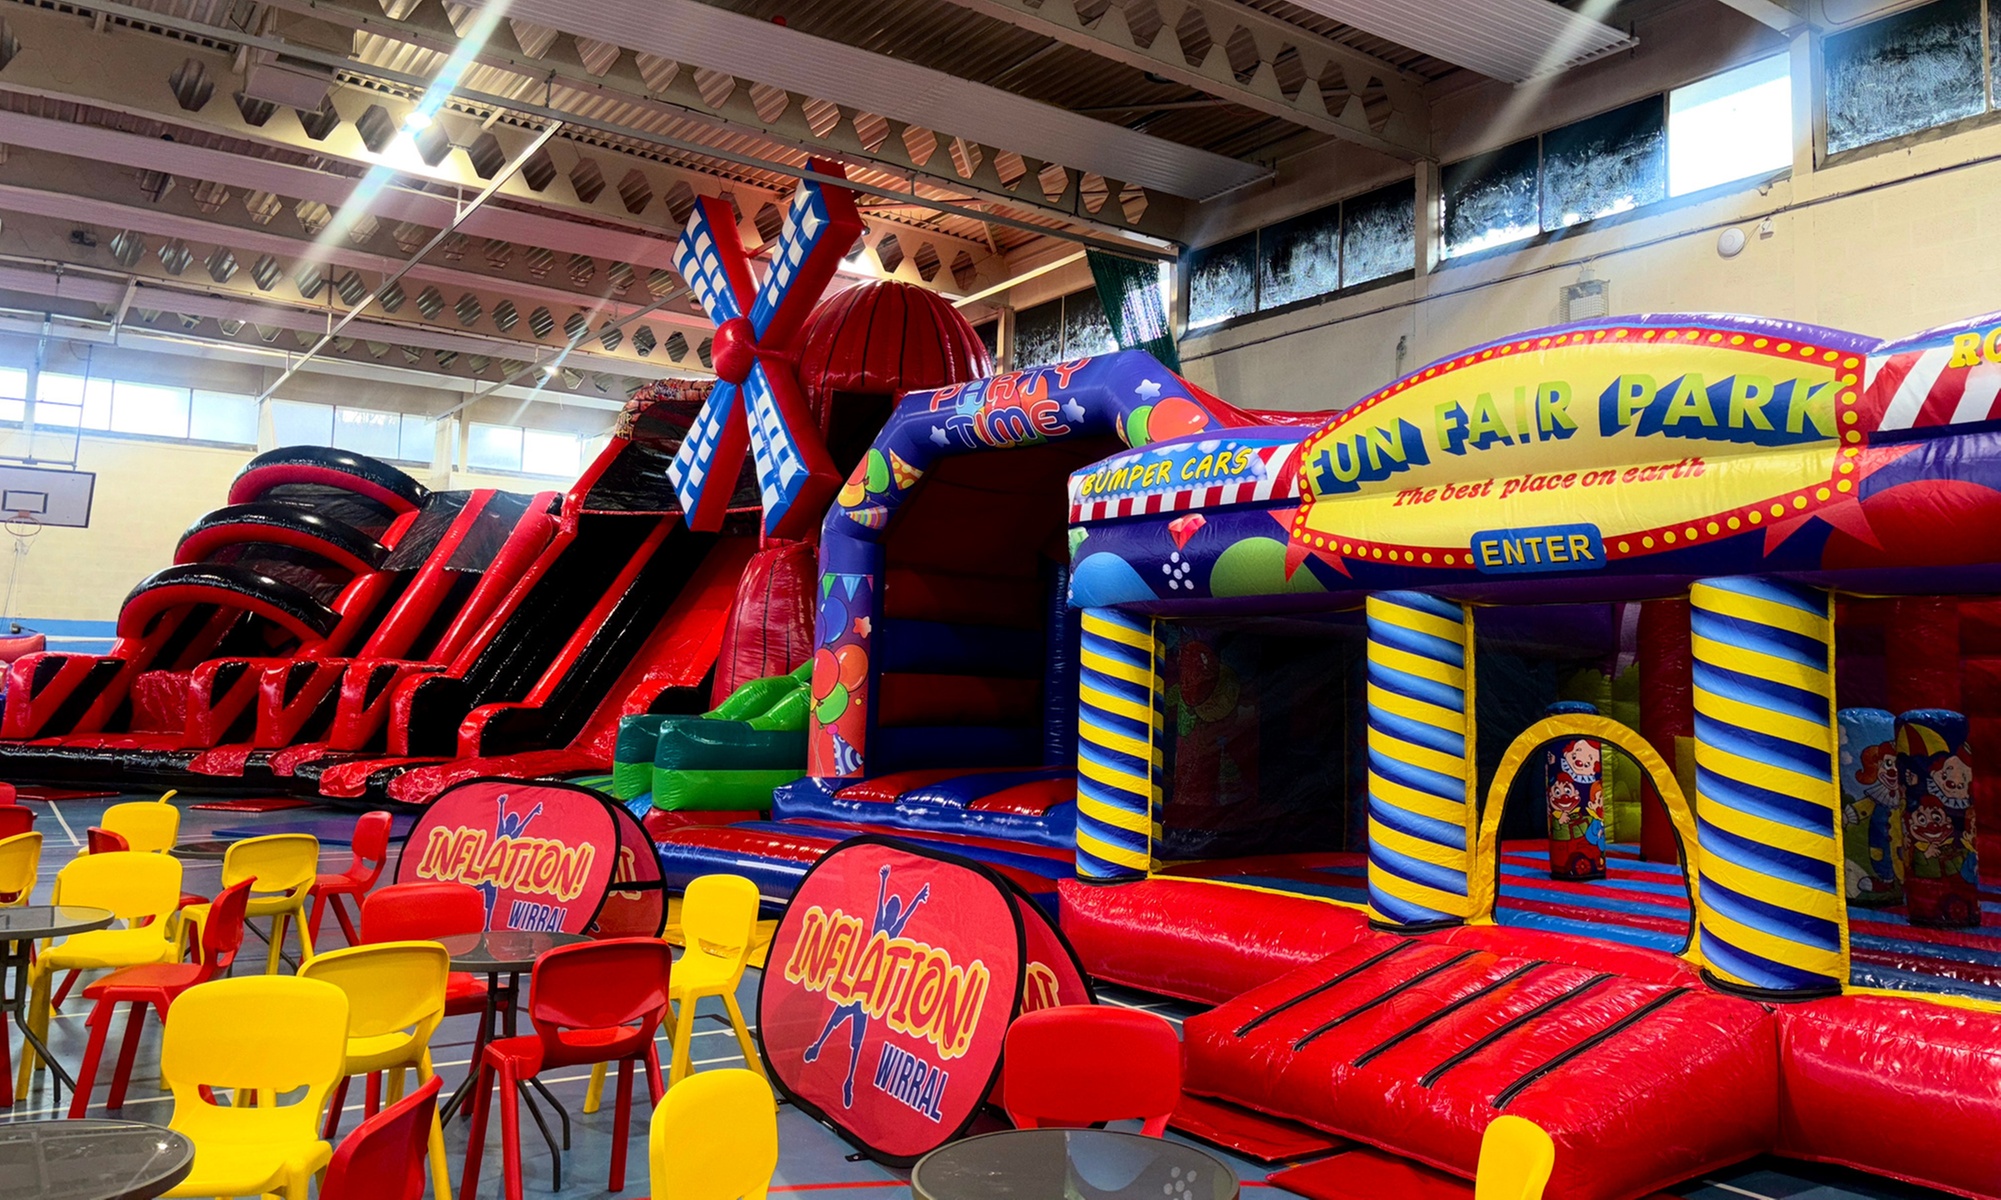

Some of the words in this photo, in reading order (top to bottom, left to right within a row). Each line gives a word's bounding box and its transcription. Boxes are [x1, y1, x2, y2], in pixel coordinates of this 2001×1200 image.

[930, 357, 1092, 412] PARTY
[946, 400, 1071, 448] TIME
[1305, 417, 1430, 496] FUN
[1434, 380, 1578, 455] FAIR
[1599, 373, 1848, 447] PARK
[1081, 460, 1172, 496] BUMPER
[1181, 447, 1253, 481] CARS
[1393, 486, 1436, 507] The
[1441, 478, 1495, 502] best
[1500, 473, 1577, 499] place
[1582, 466, 1617, 486] on
[1622, 457, 1706, 483] earth
[1480, 534, 1595, 567] ENTER
[417, 826, 595, 902] INFLATION!
[507, 899, 568, 932] WIRRAL
[784, 905, 990, 1060] INFLATION!
[873, 1042, 949, 1123] WIRRAL
